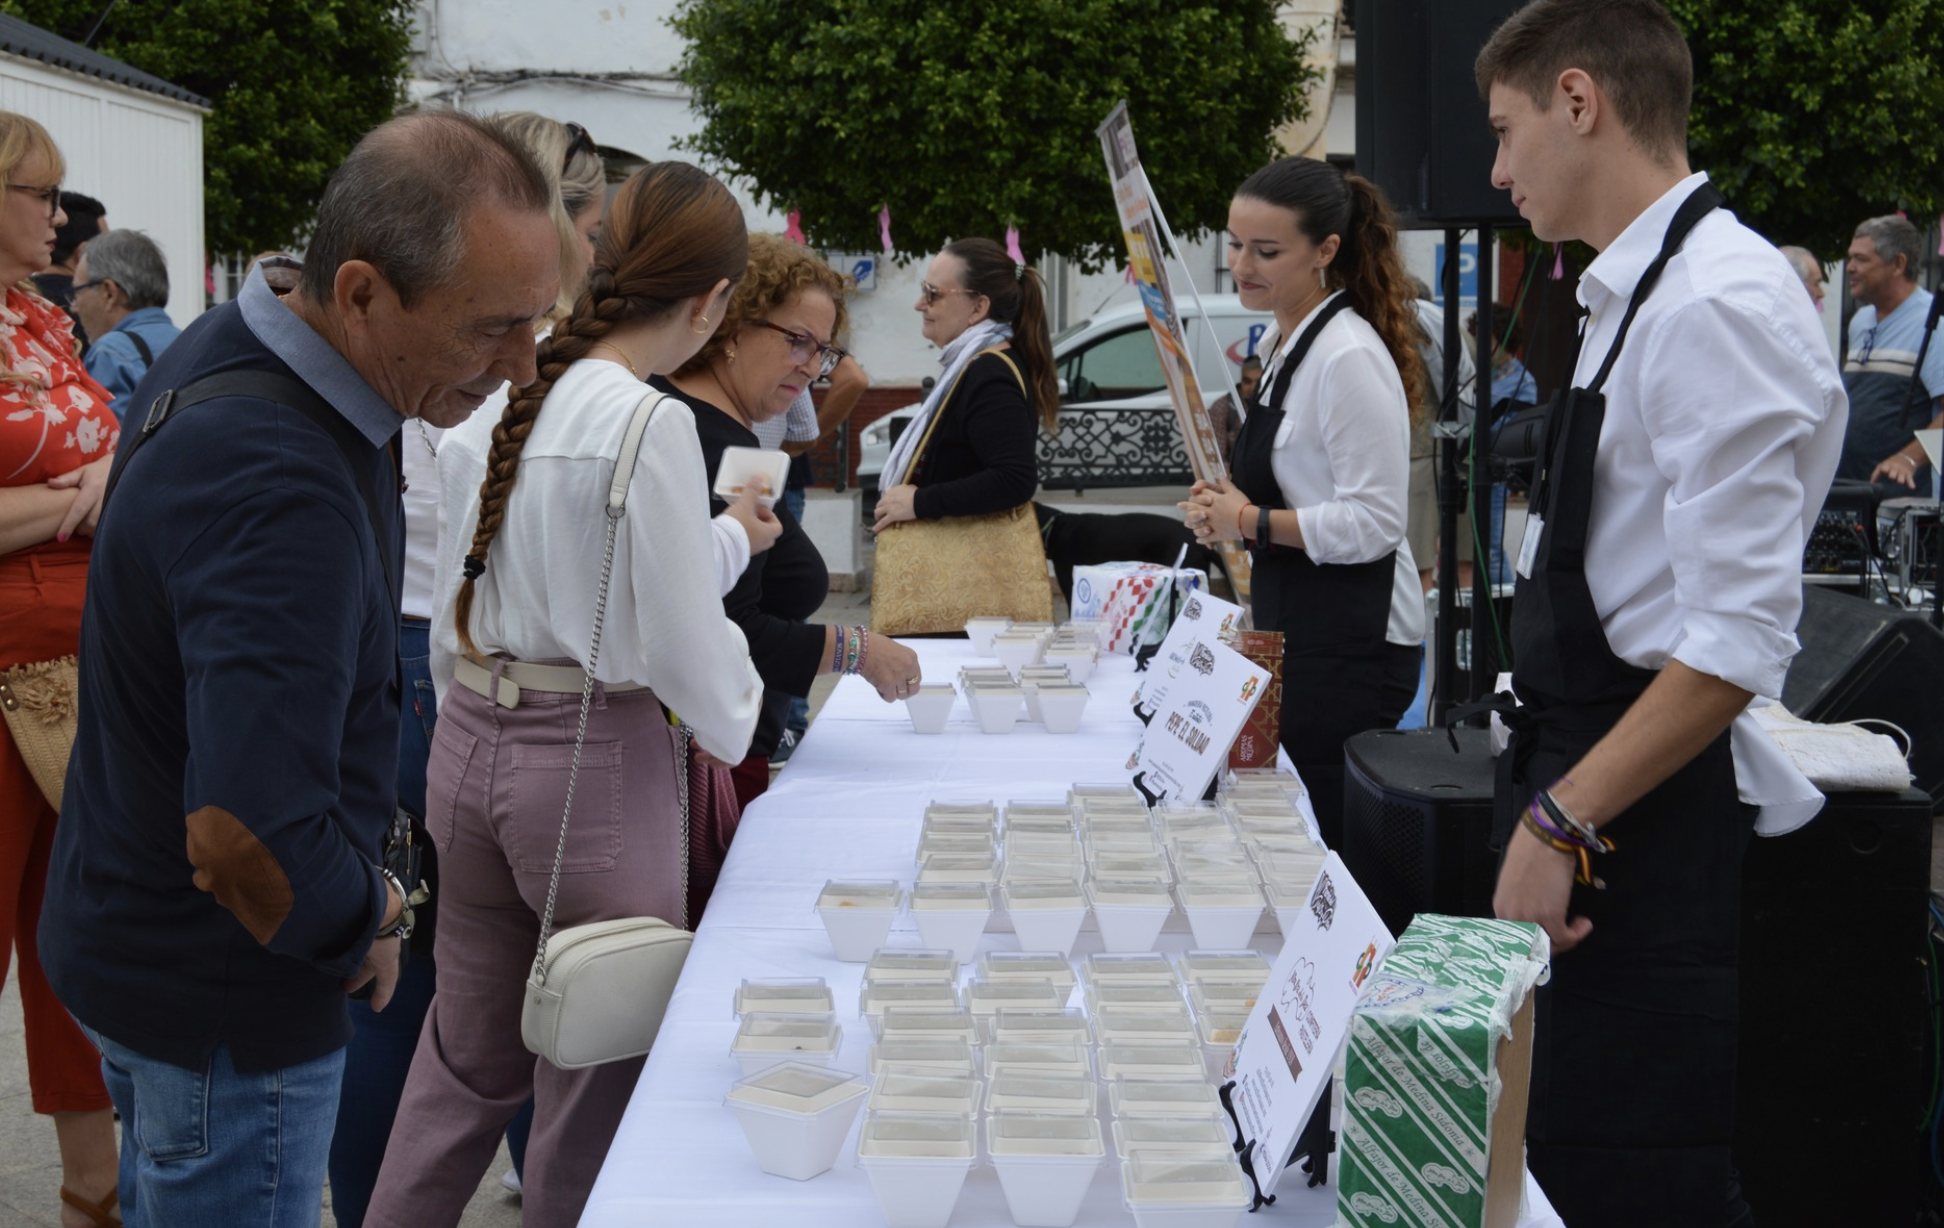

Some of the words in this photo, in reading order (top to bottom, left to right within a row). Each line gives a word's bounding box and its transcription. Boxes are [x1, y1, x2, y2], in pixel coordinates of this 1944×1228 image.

[1165, 710, 1184, 736] PEPE
[1178, 720, 1191, 741] EL
[1361, 1035, 1395, 1065] Alfajor
[1391, 1065, 1405, 1076] de
[1401, 1076, 1434, 1112] Medina
[1431, 1112, 1464, 1146] Sidonia
[1356, 1138, 1390, 1170] Alfajor
[1386, 1171, 1400, 1182] de
[1396, 1182, 1429, 1218] Medina
